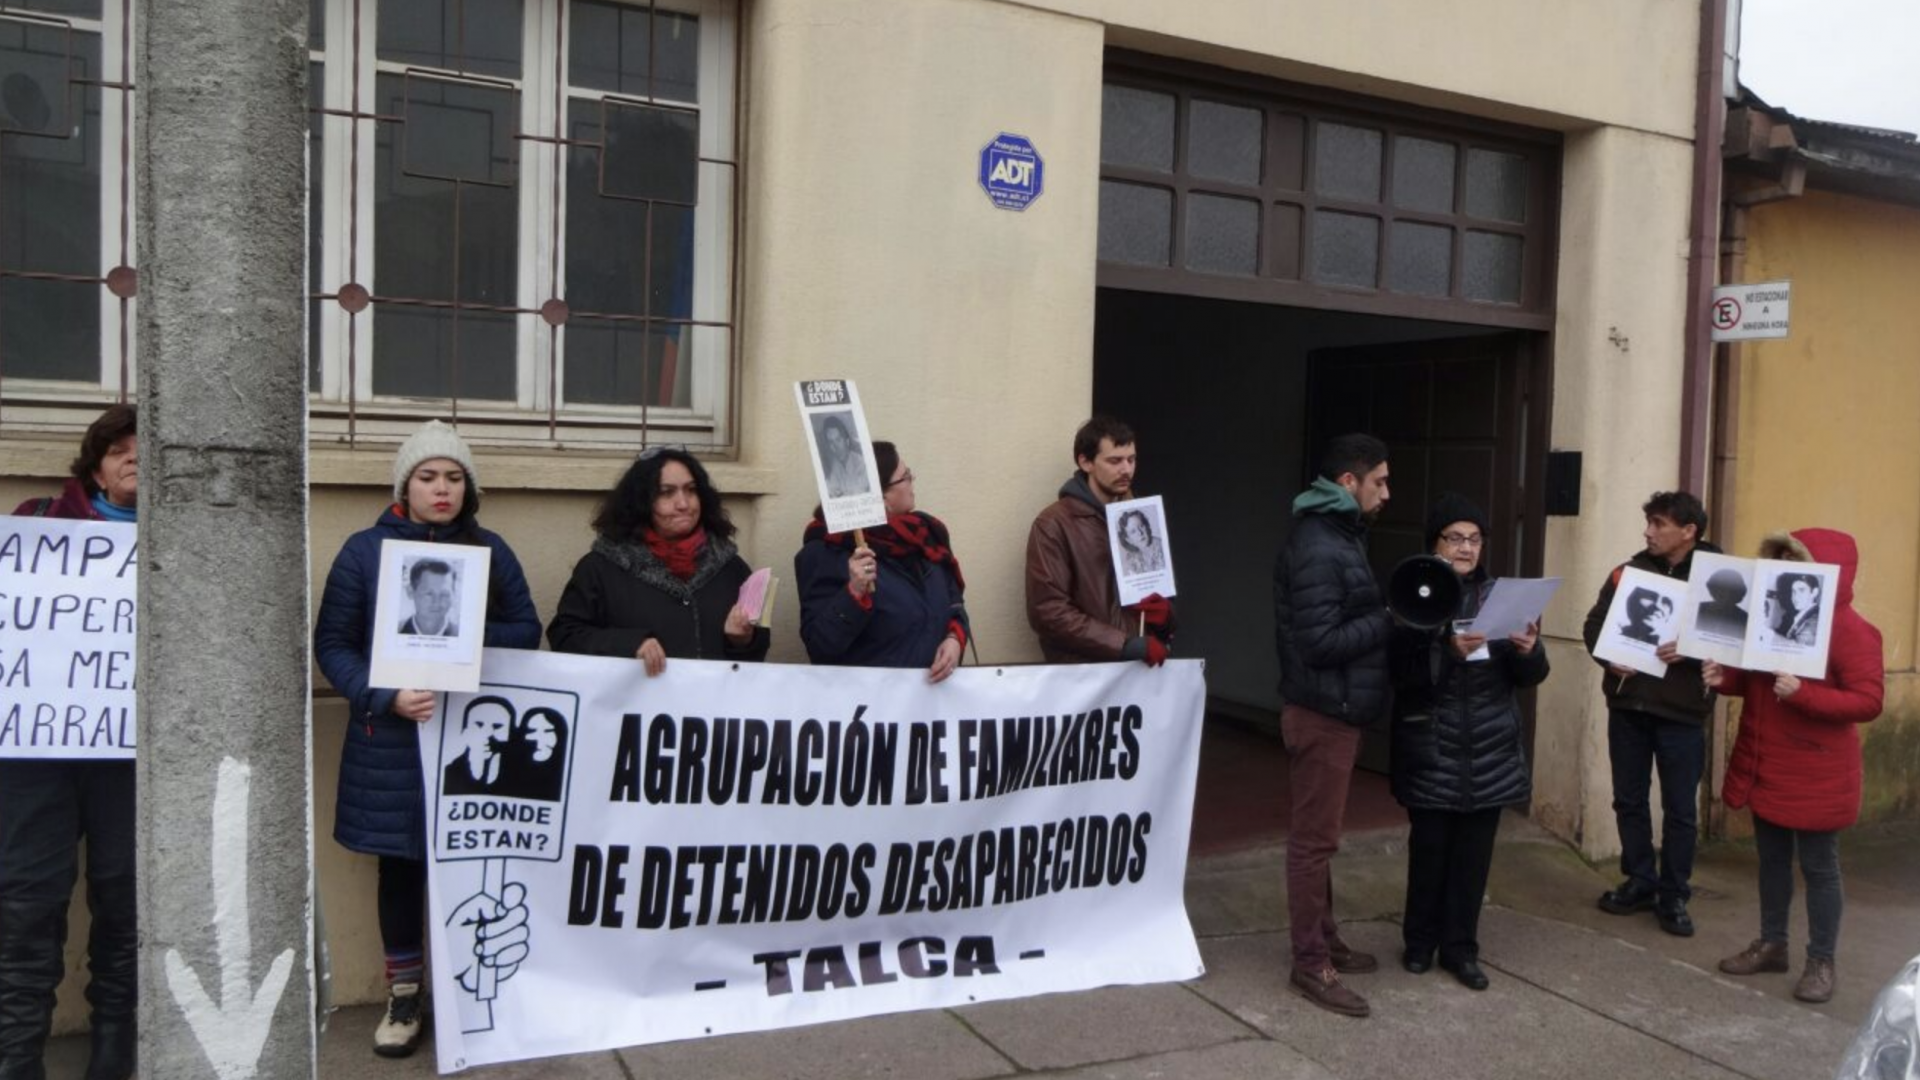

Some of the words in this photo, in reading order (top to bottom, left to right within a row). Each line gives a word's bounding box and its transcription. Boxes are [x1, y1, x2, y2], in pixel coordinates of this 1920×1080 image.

[990, 158, 1034, 187] ADT
[1762, 305, 1769, 314] A
[68, 650, 137, 690] ME
[610, 705, 898, 807] AGRUPACIÓN
[905, 719, 948, 805] DE
[958, 704, 1142, 801] FAMILIARES
[448, 801, 552, 825] ¿DONDE
[447, 830, 549, 851] ESTAN?
[567, 843, 630, 928] DE
[636, 842, 876, 930] DETENIDOS
[877, 811, 1152, 916] DESAPARECIDOS
[753, 936, 1002, 997] TALCA
